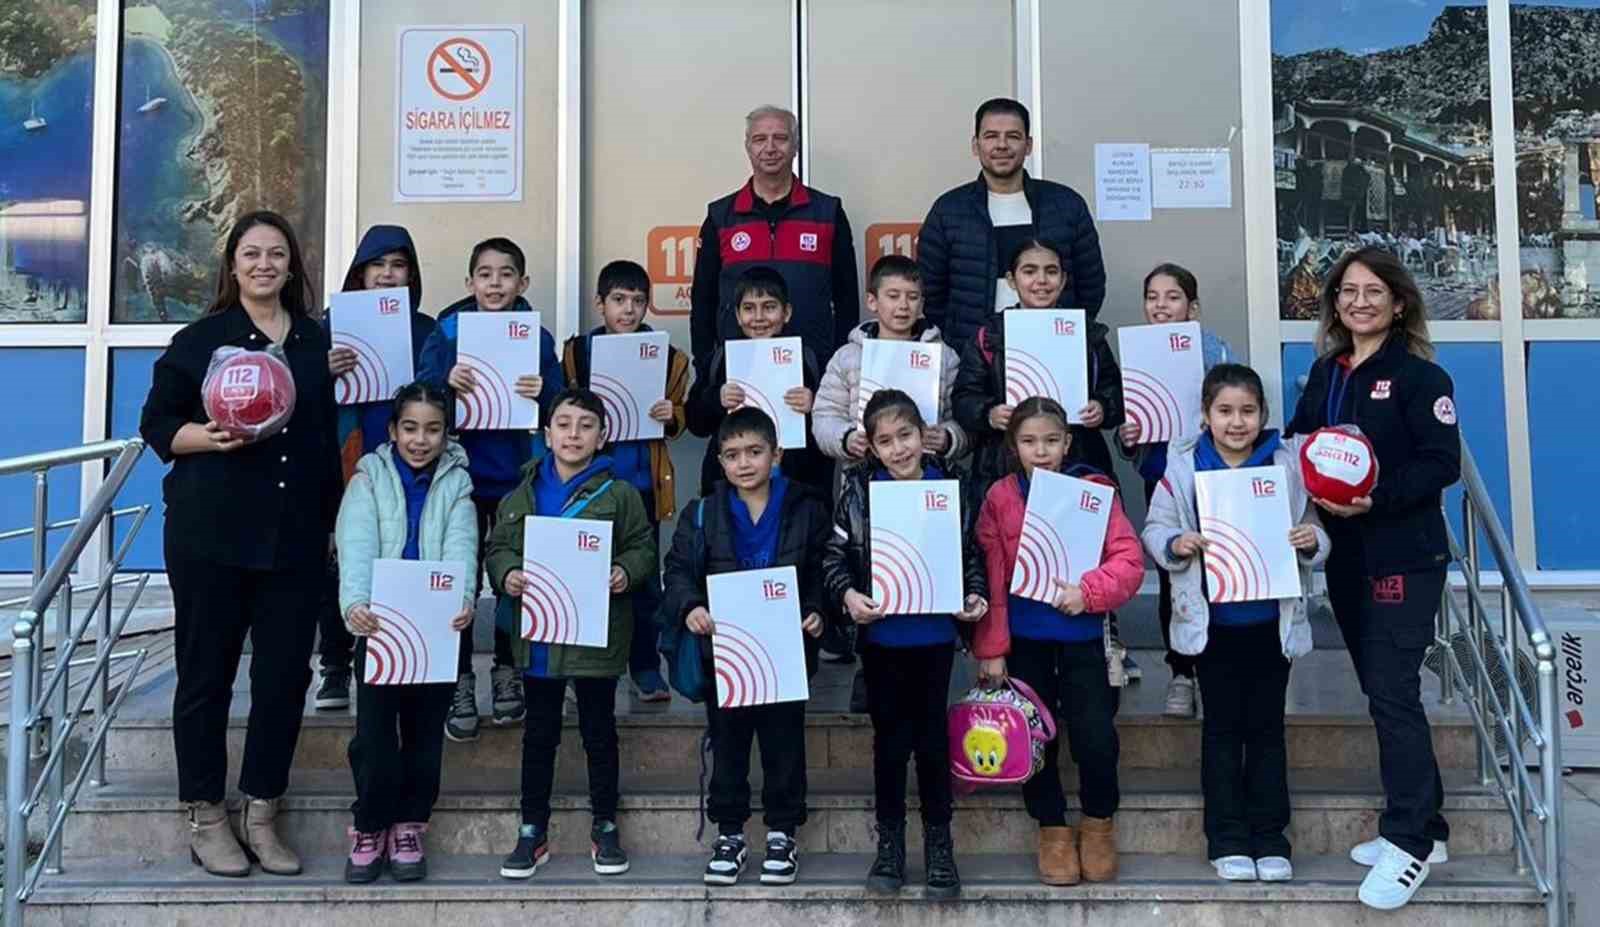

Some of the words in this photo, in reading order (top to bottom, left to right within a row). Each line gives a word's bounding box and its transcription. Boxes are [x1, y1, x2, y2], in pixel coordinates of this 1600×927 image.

[405, 107, 456, 130] SİGARA
[458, 107, 511, 134] İÇİLMEZ
[880, 234, 919, 259] 11
[661, 236, 702, 277] 11
[379, 297, 400, 314] 112
[508, 322, 531, 339] 112
[1055, 317, 1075, 335] 112
[640, 342, 660, 359] 112
[1170, 332, 1192, 352] 112
[773, 347, 793, 364] 112
[910, 351, 932, 369] 112
[228, 367, 253, 384] 112
[1343, 451, 1361, 467] 112
[1252, 477, 1276, 497] 112
[925, 491, 949, 512] 112
[1080, 491, 1102, 512] 112
[578, 531, 601, 551] 112
[430, 571, 454, 590] 112
[763, 579, 787, 599] 112
[1378, 578, 1399, 591] 112
[1561, 632, 1588, 706] arçelik
